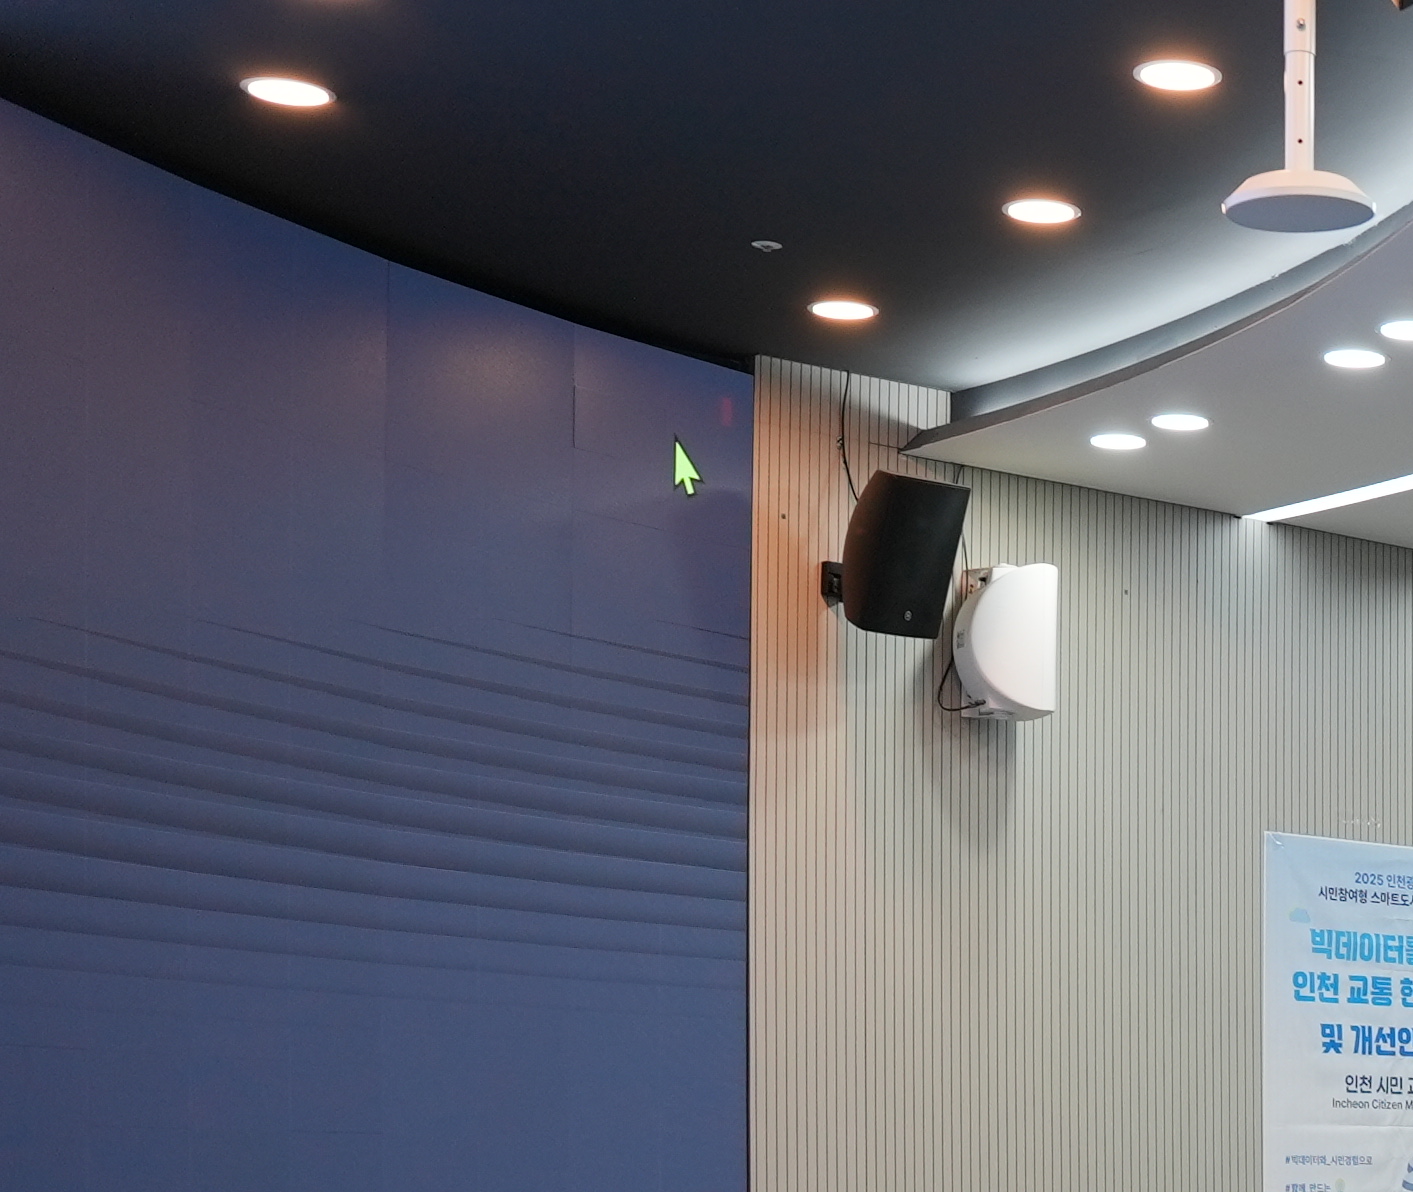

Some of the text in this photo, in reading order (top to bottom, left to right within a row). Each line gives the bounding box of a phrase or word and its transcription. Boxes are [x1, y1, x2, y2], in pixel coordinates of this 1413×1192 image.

[1354, 871, 1384, 886] 2025
[1318, 886, 1368, 904] 시민참여형
[1292, 971, 1339, 1003] 인천
[1347, 975, 1393, 1007] 교통
[1320, 1023, 1343, 1054] 및
[1345, 1075, 1372, 1094] 인천
[1376, 1076, 1403, 1095] 시민
[1332, 1097, 1370, 1110] Incheon
[1371, 1099, 1403, 1110] Citizen
